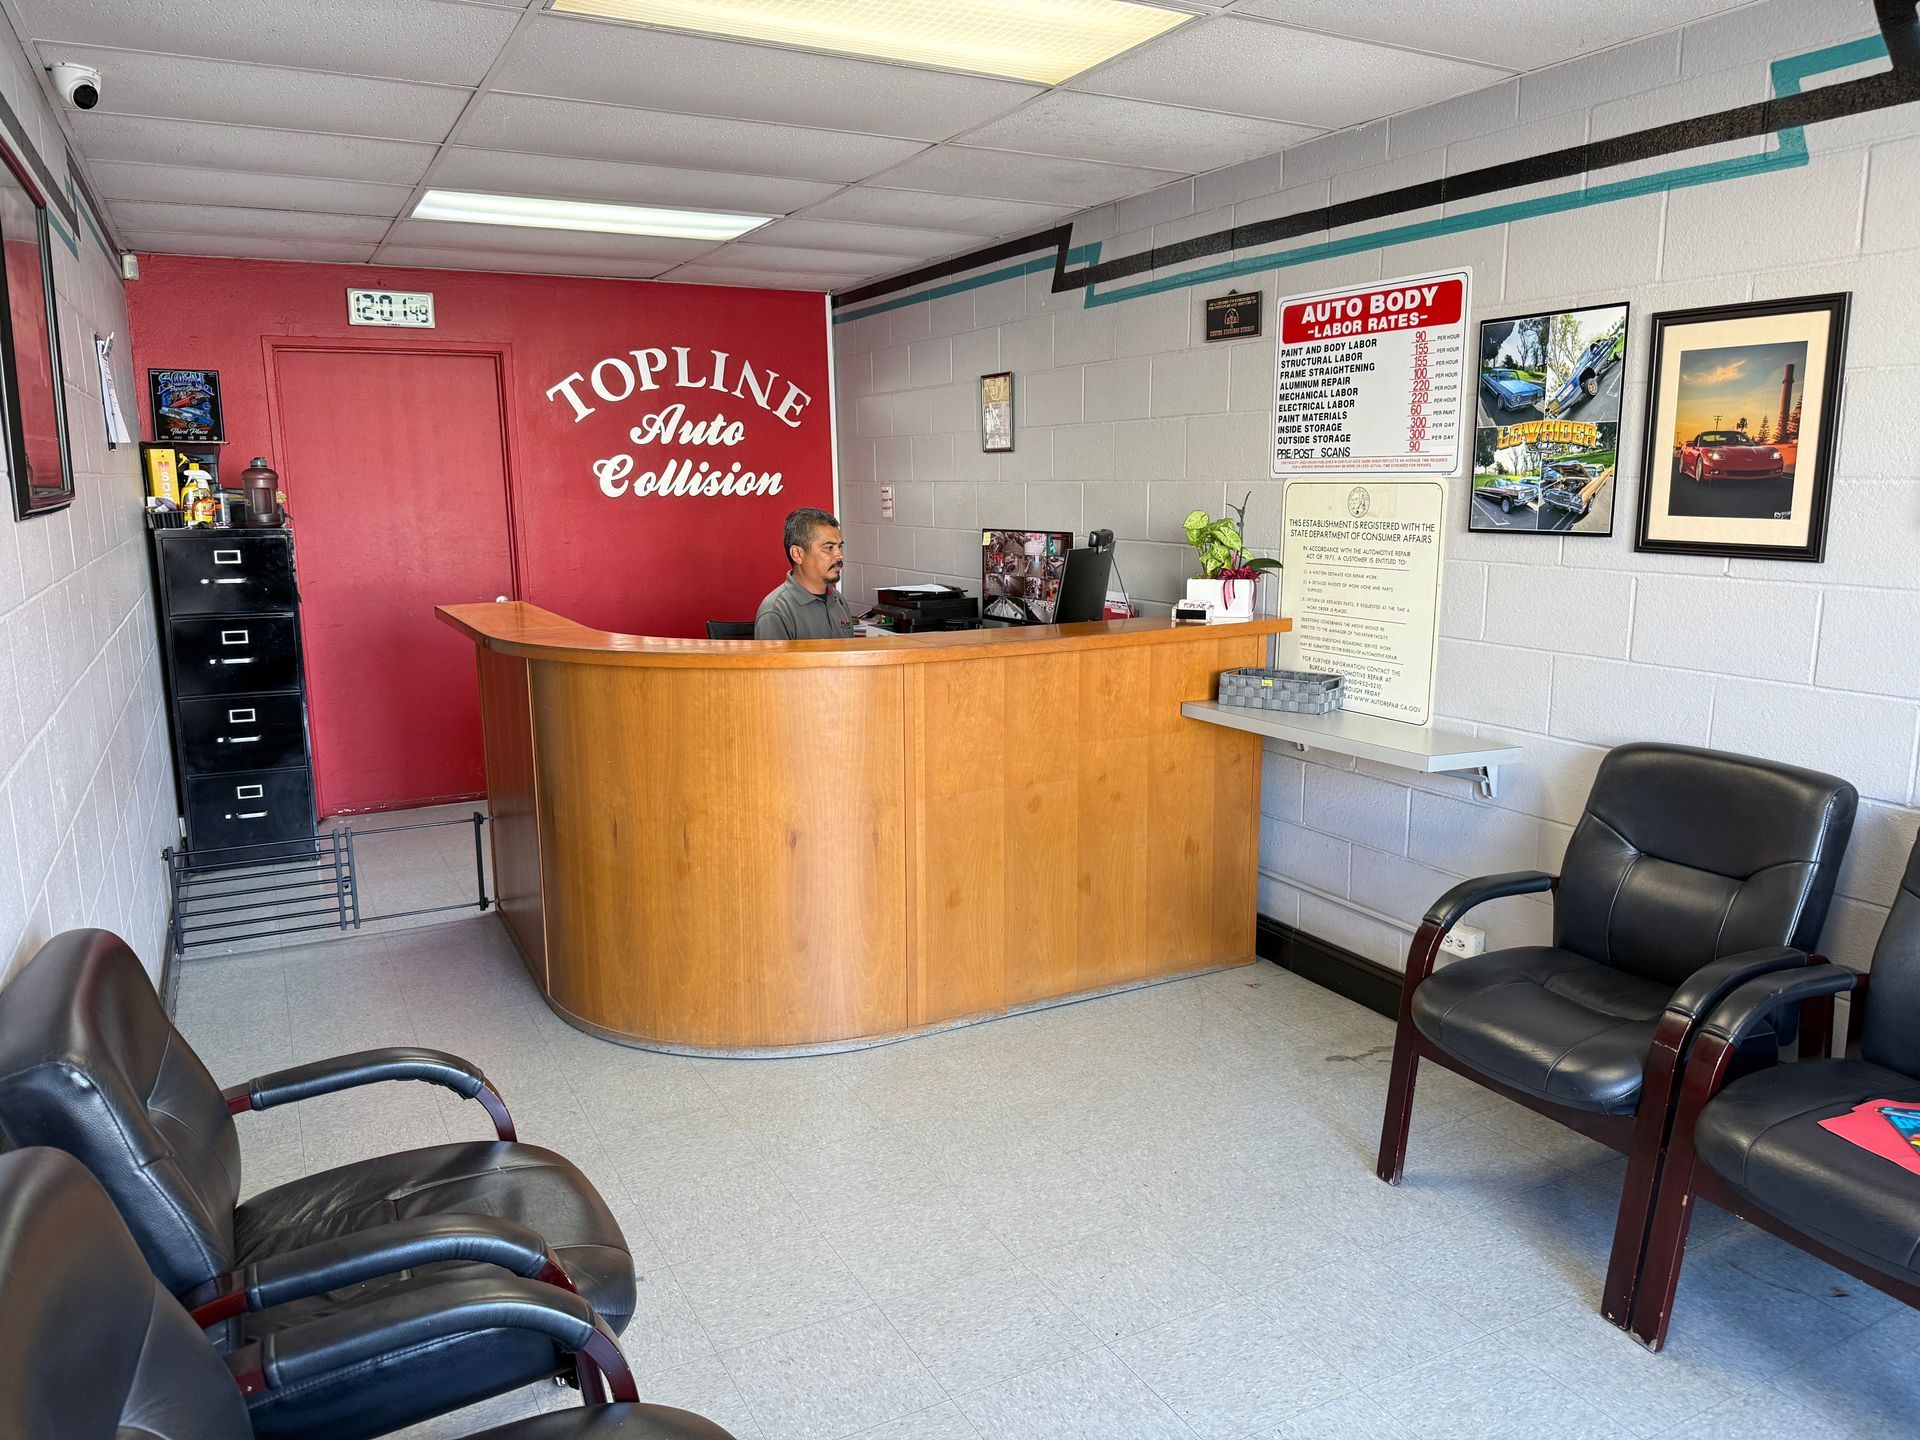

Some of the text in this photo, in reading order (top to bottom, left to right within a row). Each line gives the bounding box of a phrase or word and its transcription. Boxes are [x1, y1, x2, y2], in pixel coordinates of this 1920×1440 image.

[1301, 285, 1438, 324] AUTO BODY
[1280, 346, 1303, 357] PAINT
[1305, 344, 1321, 354] AND
[1323, 341, 1346, 352] BODY
[1348, 338, 1377, 350] LABOR
[1415, 330, 1426, 342] 90
[1280, 354, 1332, 368] STRUCTURAL
[1334, 351, 1362, 363] LABOR
[1414, 342, 1428, 355] 155
[1279, 368, 1306, 379] FRAME
[1308, 362, 1375, 376] STRAIGHTENING
[1414, 355, 1427, 367] 155
[545, 346, 812, 428] TOPLINE
[1279, 379, 1319, 390] ALUMINUM
[1321, 376, 1350, 387] REPAIR
[1413, 367, 1427, 379] 100
[1278, 389, 1328, 401] MECHANICAL
[1330, 387, 1358, 397] LABOR
[1413, 379, 1429, 391] 220
[1278, 401, 1325, 412] ELECTRICAL
[1327, 399, 1355, 409] LABOR
[1411, 391, 1428, 403] 220
[1278, 413, 1300, 422] PAINT
[1301, 411, 1347, 421] MATERIALS
[1410, 404, 1421, 415] 60
[630, 403, 745, 446] Auto
[1277, 424, 1301, 433] INSIDE
[1304, 422, 1342, 432] STORAGE
[1410, 416, 1426, 428] 300
[1497, 420, 1598, 450] LOWRIDER
[1277, 435, 1310, 444] OUTSIDE
[1312, 433, 1350, 443] STORAGE
[1409, 428, 1425, 439] 300
[1320, 446, 1350, 458] SCANS
[1408, 440, 1420, 451] 90
[593, 453, 784, 498] Collision
[1289, 518, 1435, 531] THIS ESTABLISHMENT IS REGISTERED WITH THE
[1290, 528, 1432, 543] STATE DEPARTMENT OF CONSUMER AFFAIRS
[1362, 548, 1393, 556] AUTOMOTIVE
